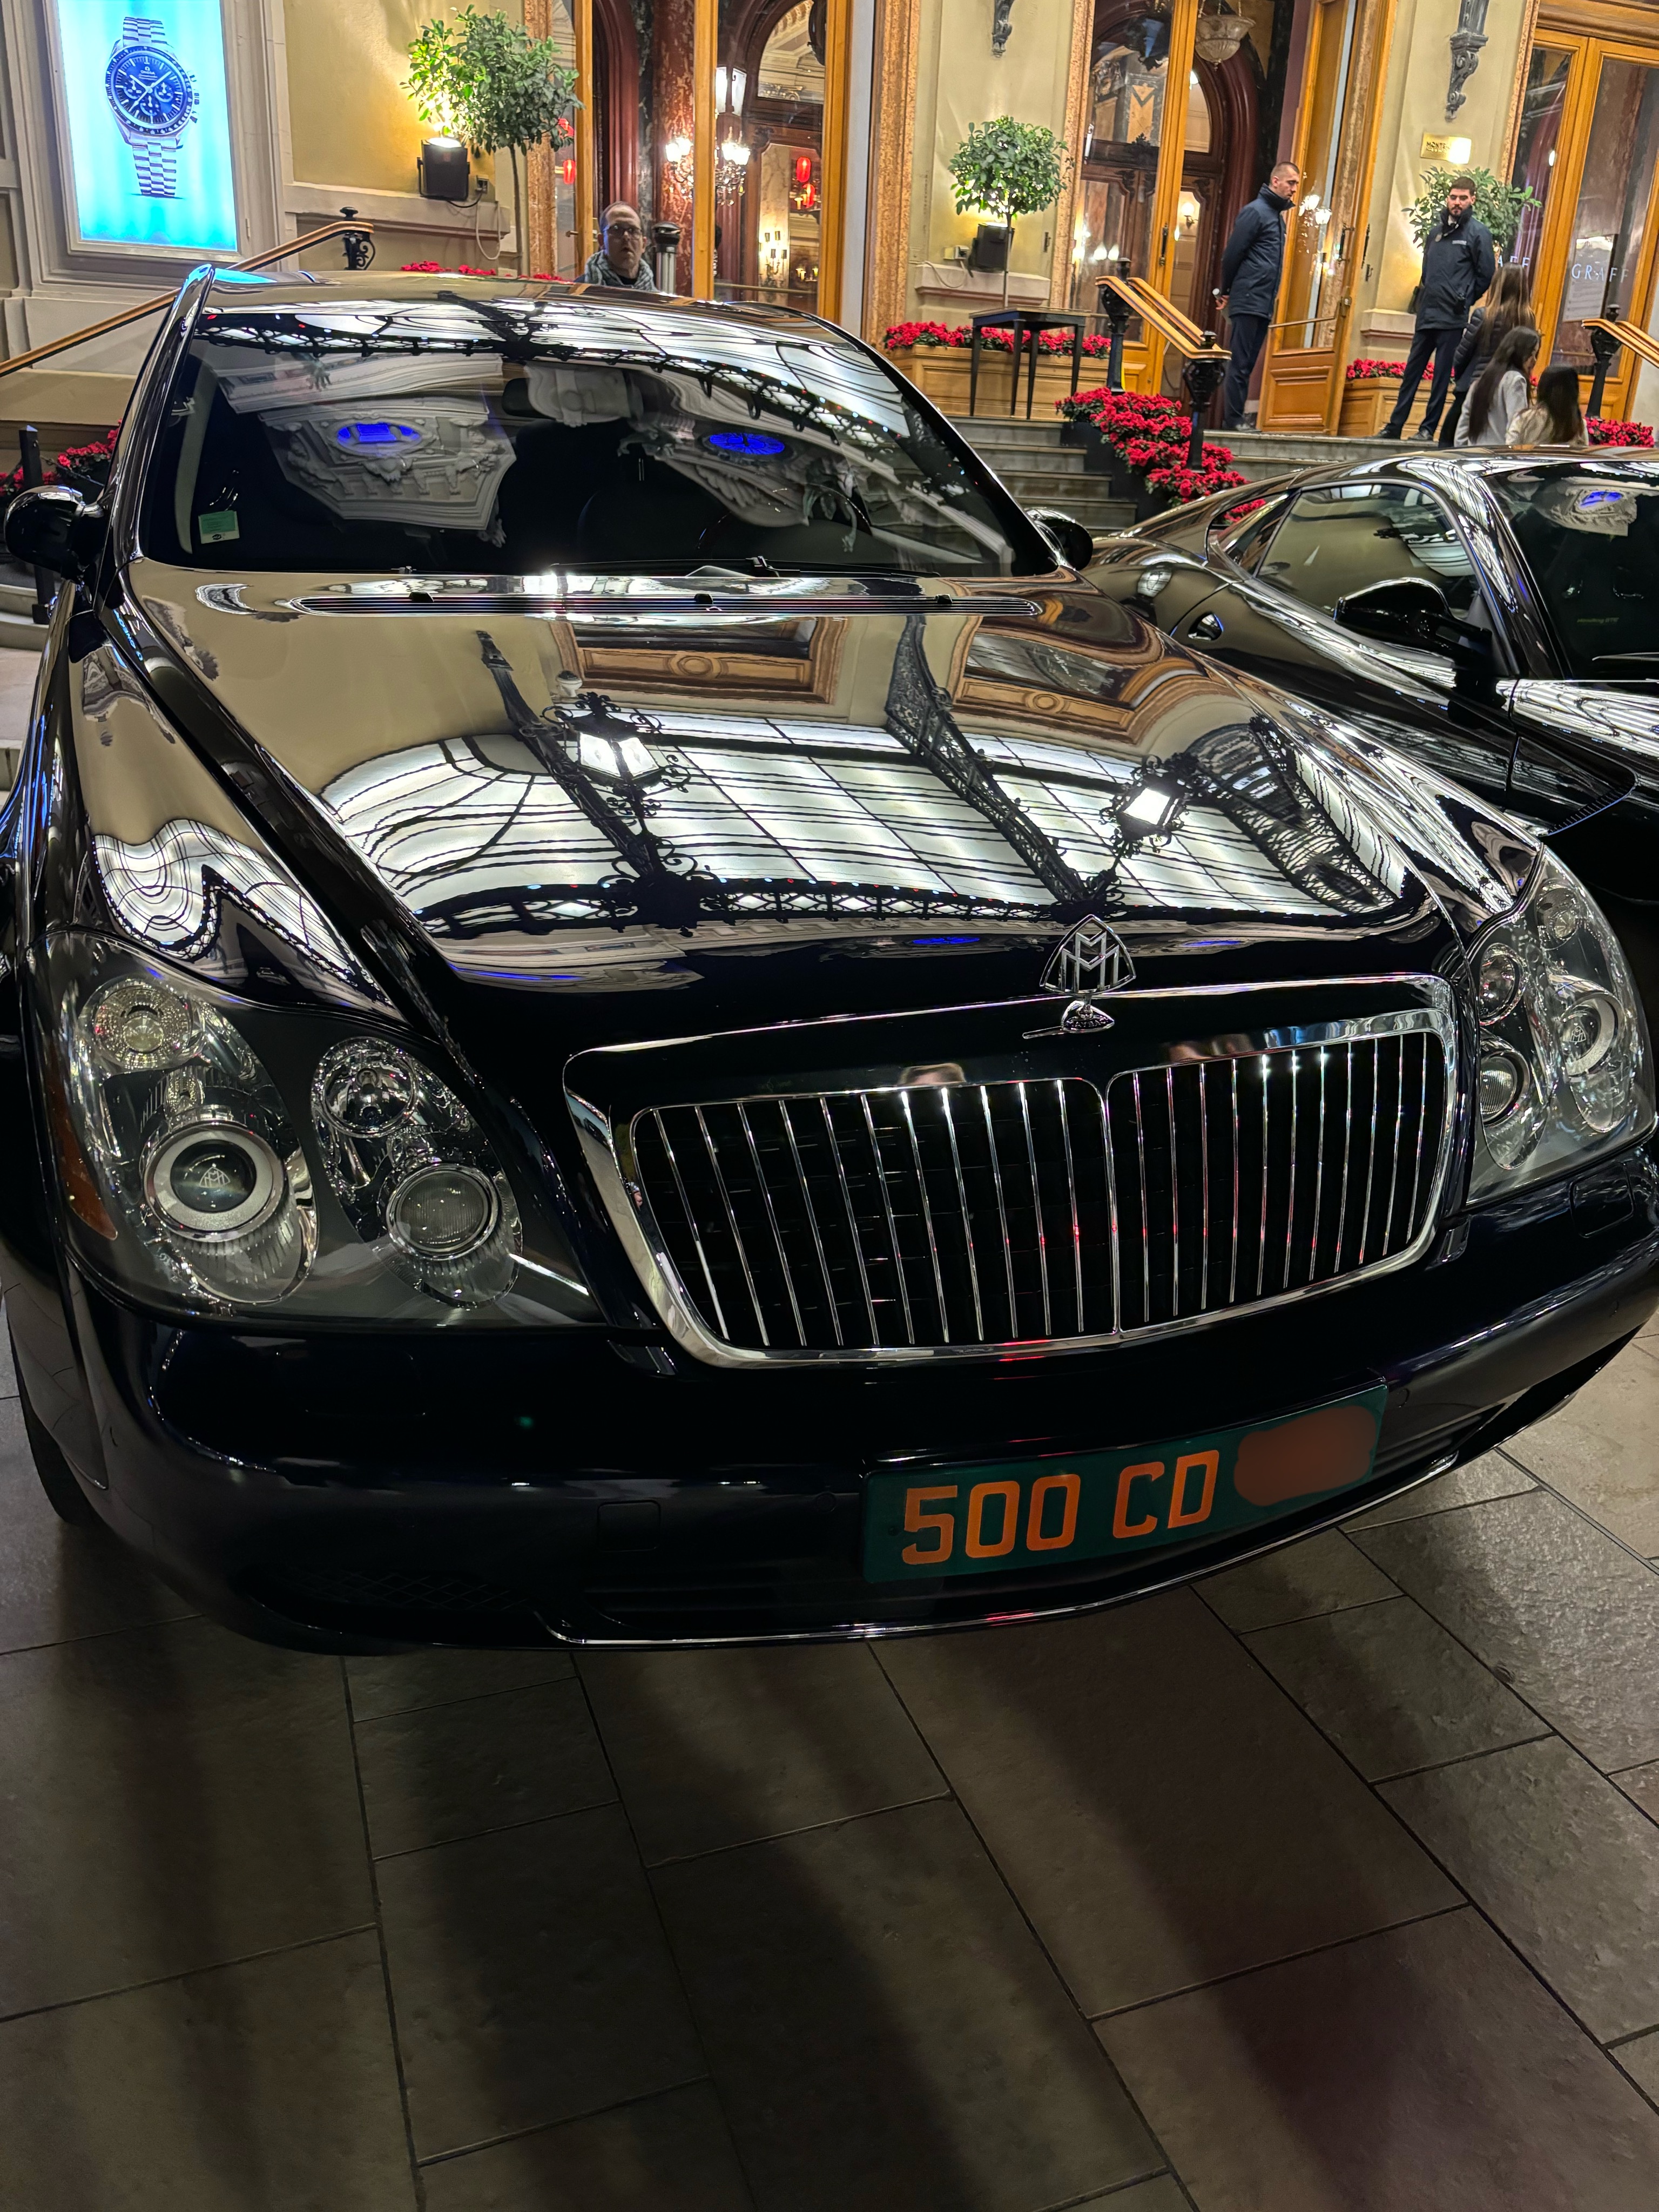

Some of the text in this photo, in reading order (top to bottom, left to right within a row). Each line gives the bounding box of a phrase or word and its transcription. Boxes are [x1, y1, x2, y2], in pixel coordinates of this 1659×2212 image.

[1572, 264, 1629, 283] GRAFF
[902, 1450, 1219, 1564] 500 CD
